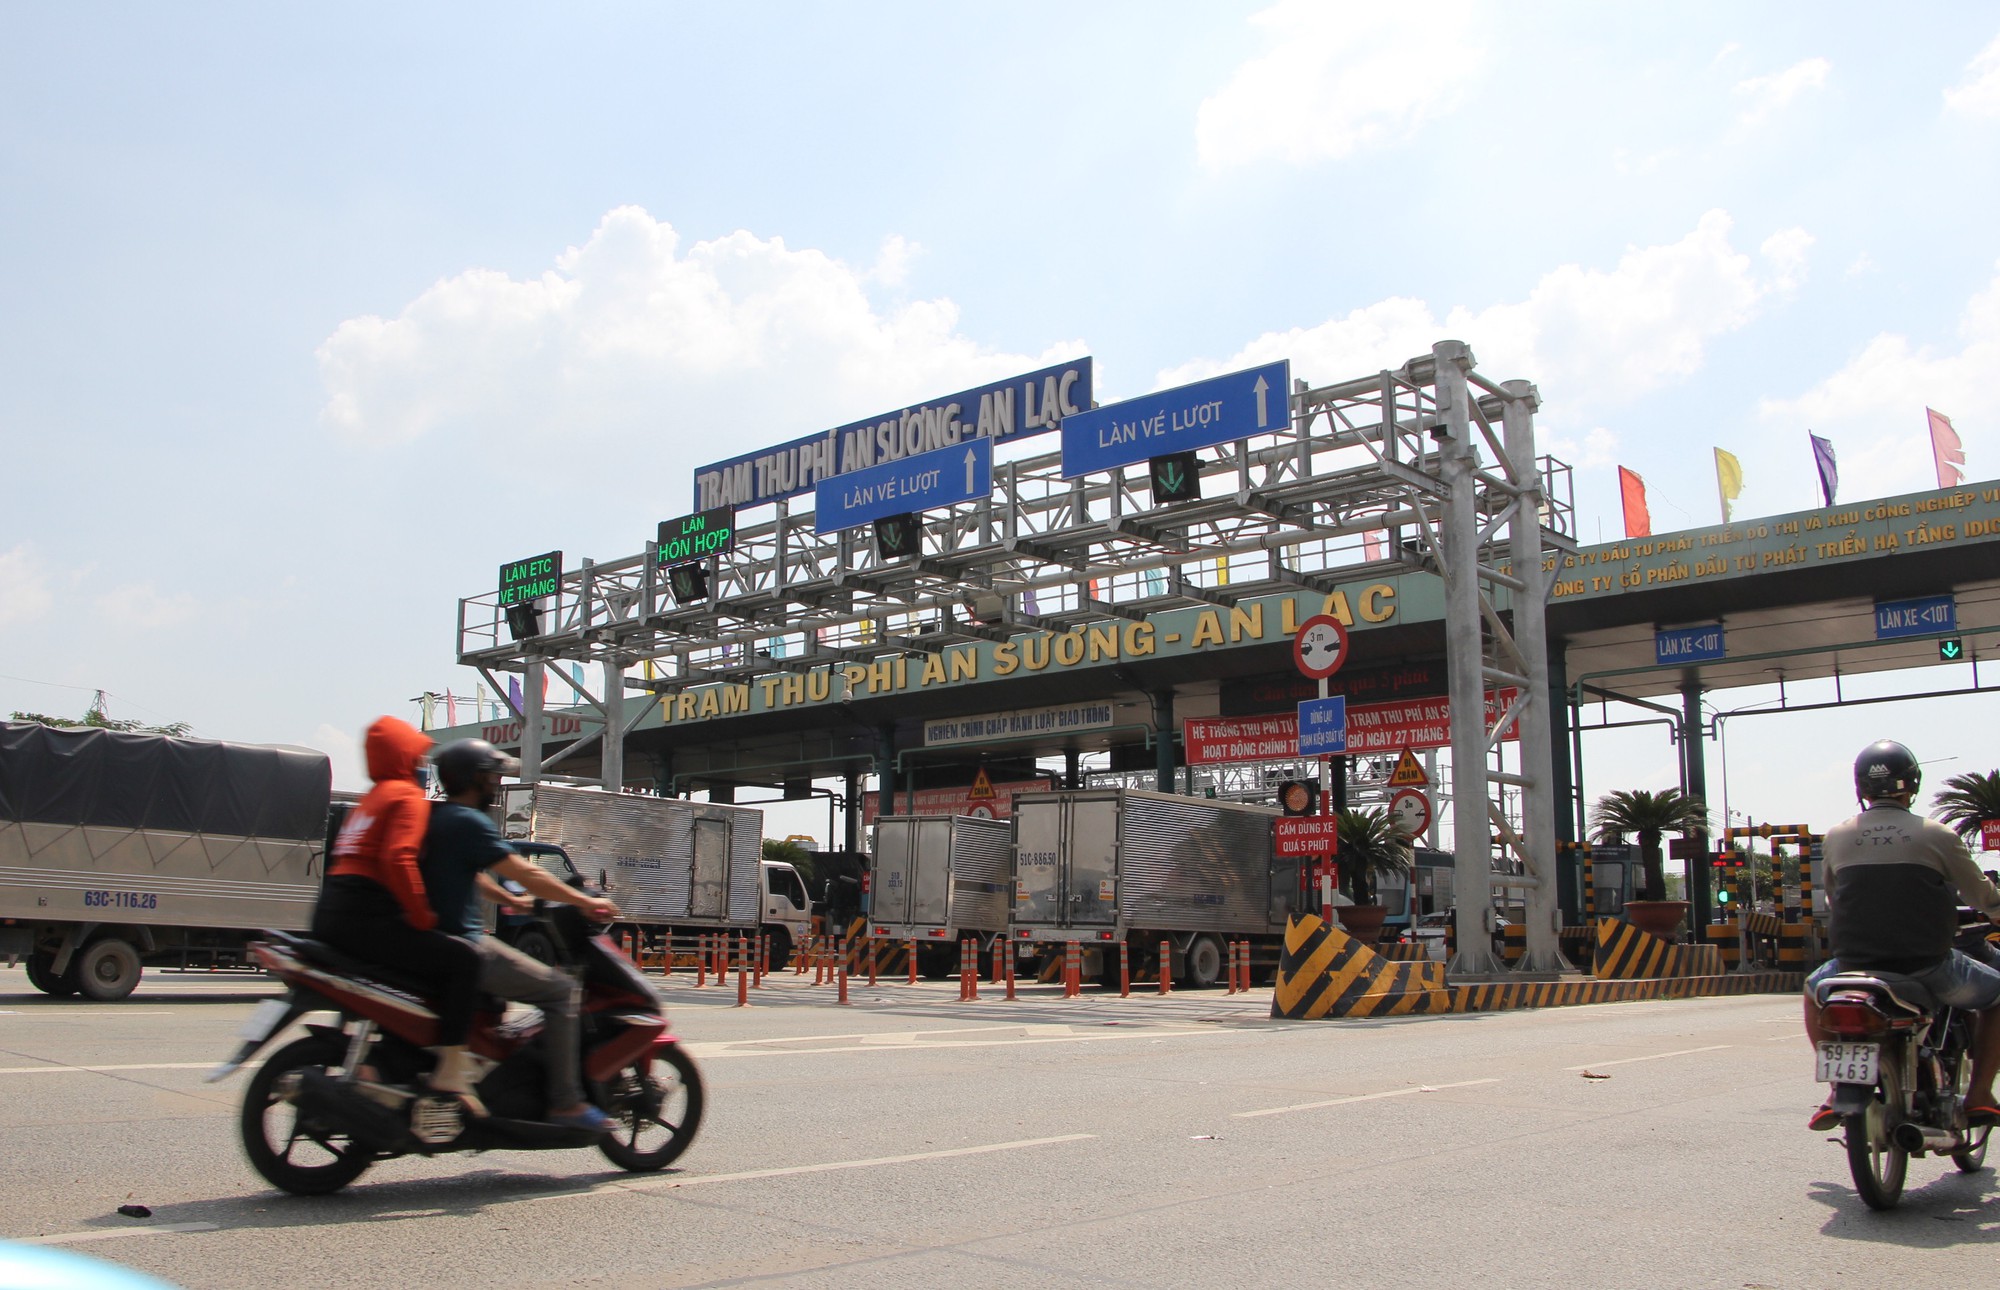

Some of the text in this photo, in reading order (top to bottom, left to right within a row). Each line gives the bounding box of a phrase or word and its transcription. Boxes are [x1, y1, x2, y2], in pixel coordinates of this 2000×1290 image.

[755, 448, 797, 498] THU
[798, 428, 838, 488] PHÍ
[842, 426, 875, 474] AN
[1024, 369, 1079, 430] LẠC
[1099, 401, 1223, 448] LÀN VÉ LƯỢT
[843, 469, 940, 511] LÀN VÉ LƯỢT
[682, 516, 705, 535] LÀN
[1541, 555, 1575, 572] CÔG
[1579, 552, 1598, 567] TY
[1601, 543, 1630, 563] ĐẦU
[1634, 543, 1653, 558] TƯ
[1657, 535, 1694, 555] PHÁT
[1701, 527, 1742, 548] TRIỂN
[1747, 522, 1768, 540] ĐÔ
[1775, 519, 1800, 538] THỊ
[1804, 513, 1822, 531] VÀ
[1828, 510, 1860, 528] KHU
[1864, 502, 1911, 522] CÔNG
[1915, 491, 1976, 513] NGHIỆP
[694, 528, 730, 555] HỢP
[505, 558, 553, 583] LÀN ETC
[1553, 576, 1585, 598] ÔNG
[1591, 577, 1612, 592] TY
[1619, 563, 1642, 588] CỔ
[1647, 559, 1690, 585] PHẦN
[1695, 553, 1729, 577] ĐẦU
[1733, 553, 1756, 572] TƯ
[1763, 542, 1807, 567] PHÁT
[1815, 529, 1867, 560] TRIỂN
[1874, 532, 1899, 554] HẠ
[1904, 520, 1956, 545] TẦNG
[500, 577, 556, 605] VÉ THÁNG
[1880, 604, 1949, 630] LÀN XE <10T
[1660, 633, 1718, 657] LÀN XE <10T
[659, 684, 751, 722] TRẠM
[761, 672, 831, 709] THU
[845, 652, 908, 693] PHÍ
[920, 648, 979, 686] AN
[992, 621, 1156, 676] SƯƠNG
[1191, 602, 1264, 648] AN
[928, 721, 959, 741] NGHIÊM
[1010, 713, 1033, 732] HÀNH
[1035, 710, 1056, 732] LUẬT
[1059, 708, 1079, 727] GIAO
[1081, 703, 1110, 724] THÔNG
[1193, 722, 1206, 742] HỆ
[1208, 720, 1240, 739] THỐNG
[1241, 722, 1261, 736] THU
[1263, 717, 1279, 735] PHÍ
[1351, 711, 1381, 730] TRẠM
[1382, 709, 1403, 724] THU
[1405, 704, 1423, 721] PHÍ
[1425, 706, 1440, 719] AN
[1203, 744, 1227, 760] HOẠT
[1230, 740, 1256, 758] ĐỘNG
[1258, 738, 1287, 756] CHÍNH
[1347, 731, 1364, 748] GIỜ
[1366, 727, 1392, 745] NGÀY
[1395, 730, 1407, 744] 27
[1409, 725, 1444, 742] THÁNG
[1279, 819, 1333, 835] CẤM DỪNG XE
[1855, 825, 1912, 846] COUPLE
[1283, 837, 1329, 853] QUÁ 5 PHÚT
[1020, 851, 1056, 866] 51C-886.50
[85, 891, 158, 909] 63C-116.26
[1825, 1044, 1870, 1062] 69-F3
[1824, 1063, 1868, 1081] 1463
